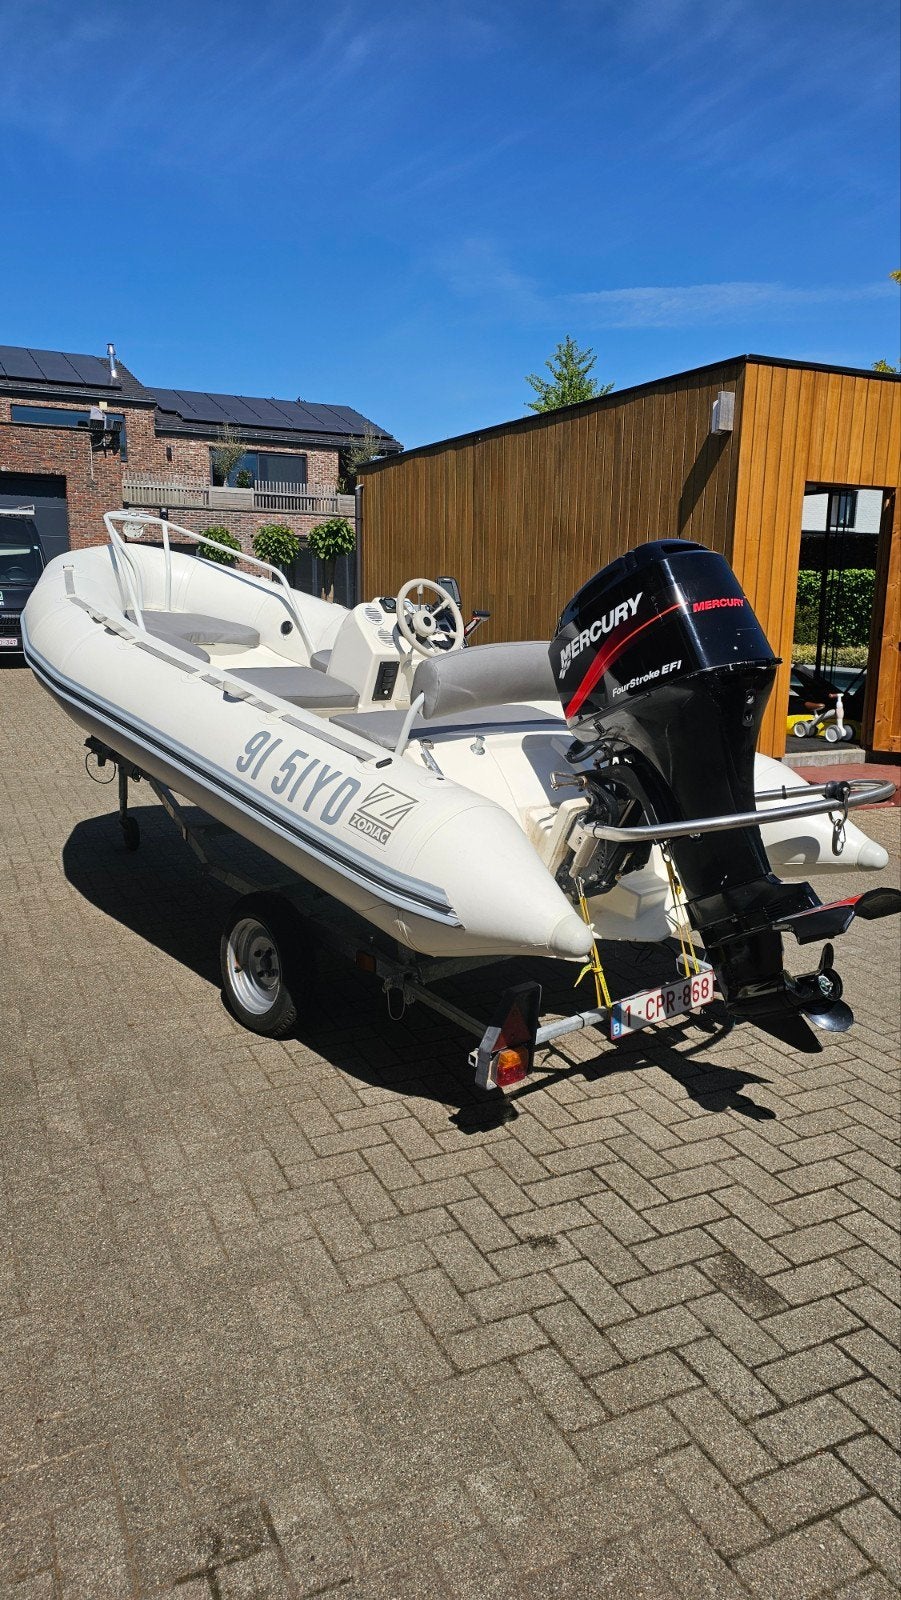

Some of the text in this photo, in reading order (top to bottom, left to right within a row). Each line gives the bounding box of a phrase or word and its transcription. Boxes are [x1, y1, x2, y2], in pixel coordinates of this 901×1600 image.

[693, 598, 744, 612] MERCURY
[559, 592, 643, 678] MERCURY
[612, 660, 683, 697] FourStroke EFI
[349, 813, 391, 844] ZODIAC
[613, 1023, 620, 1035] B
